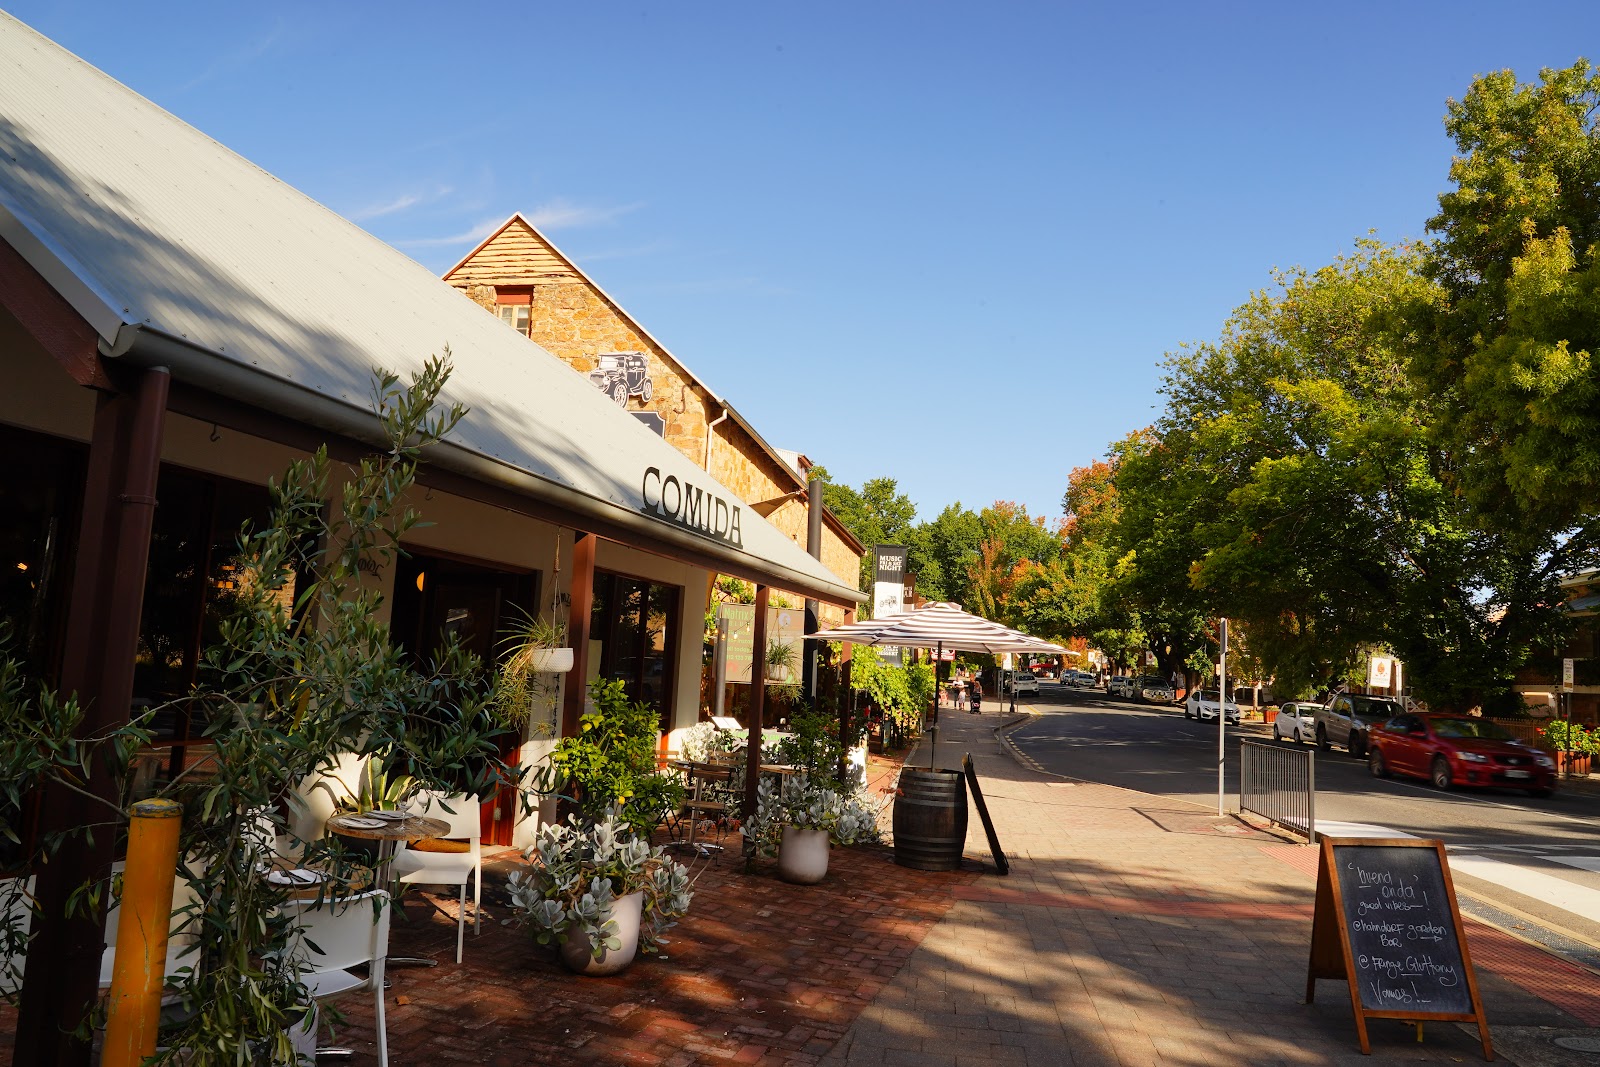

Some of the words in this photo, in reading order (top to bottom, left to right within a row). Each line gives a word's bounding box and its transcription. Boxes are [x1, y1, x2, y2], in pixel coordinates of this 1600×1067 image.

[642, 466, 743, 550] COMIDA
[724, 607, 749, 621] Matrix
[1358, 897, 1382, 915] good
[1358, 954, 1369, 969] @
